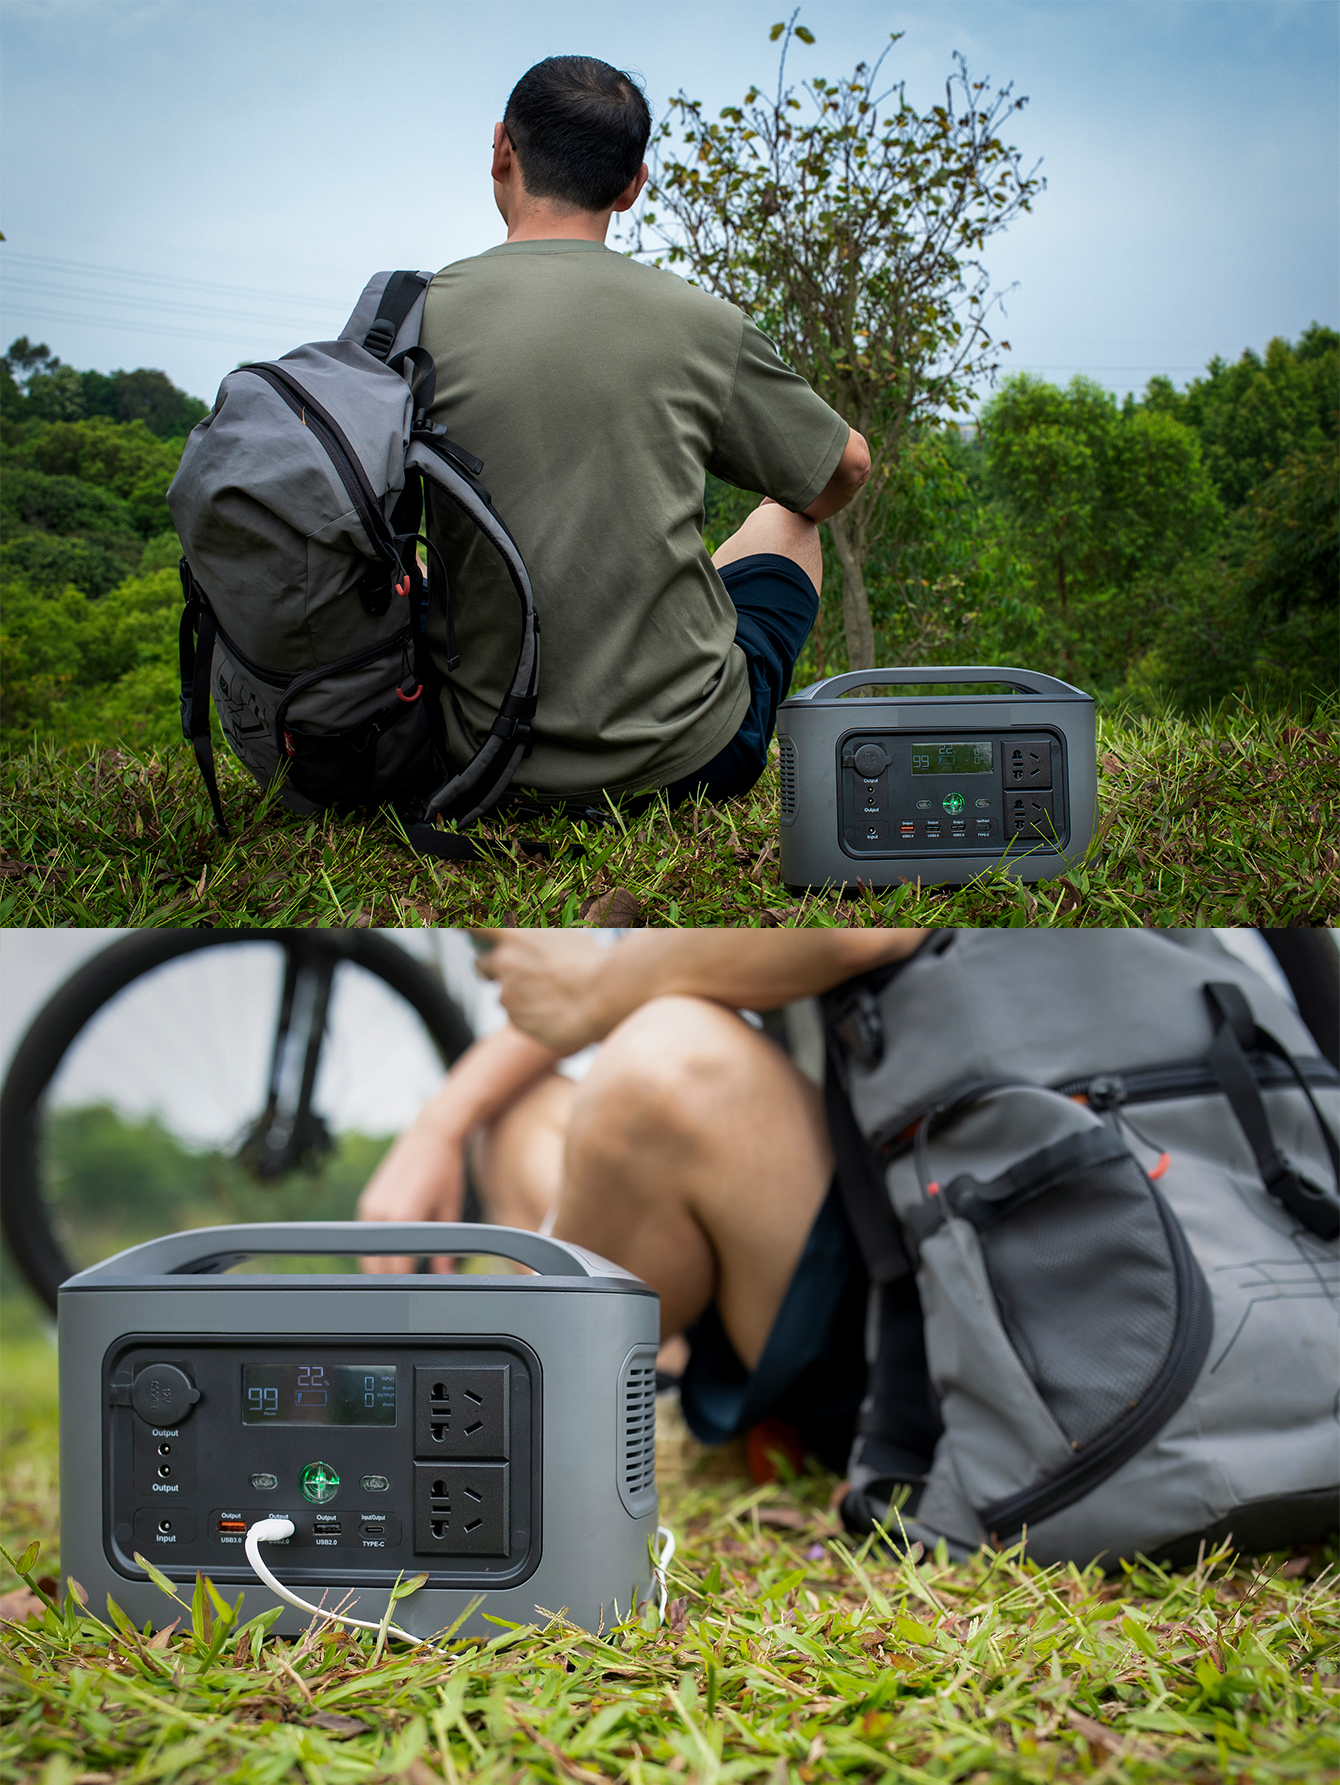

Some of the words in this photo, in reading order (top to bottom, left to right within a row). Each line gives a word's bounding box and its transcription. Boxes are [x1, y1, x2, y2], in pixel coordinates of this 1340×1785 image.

[912, 754, 930, 767] 99
[364, 1376, 375, 1391] 0
[248, 1387, 279, 1411] 99
[364, 1392, 375, 1408] 0
[152, 1428, 179, 1438] Output
[152, 1483, 179, 1493] Output
[221, 1512, 242, 1520] Output
[316, 1514, 337, 1522] Output
[361, 1514, 386, 1522] Input/Output
[156, 1534, 177, 1544] Input
[362, 1540, 385, 1548] TYPE-C
